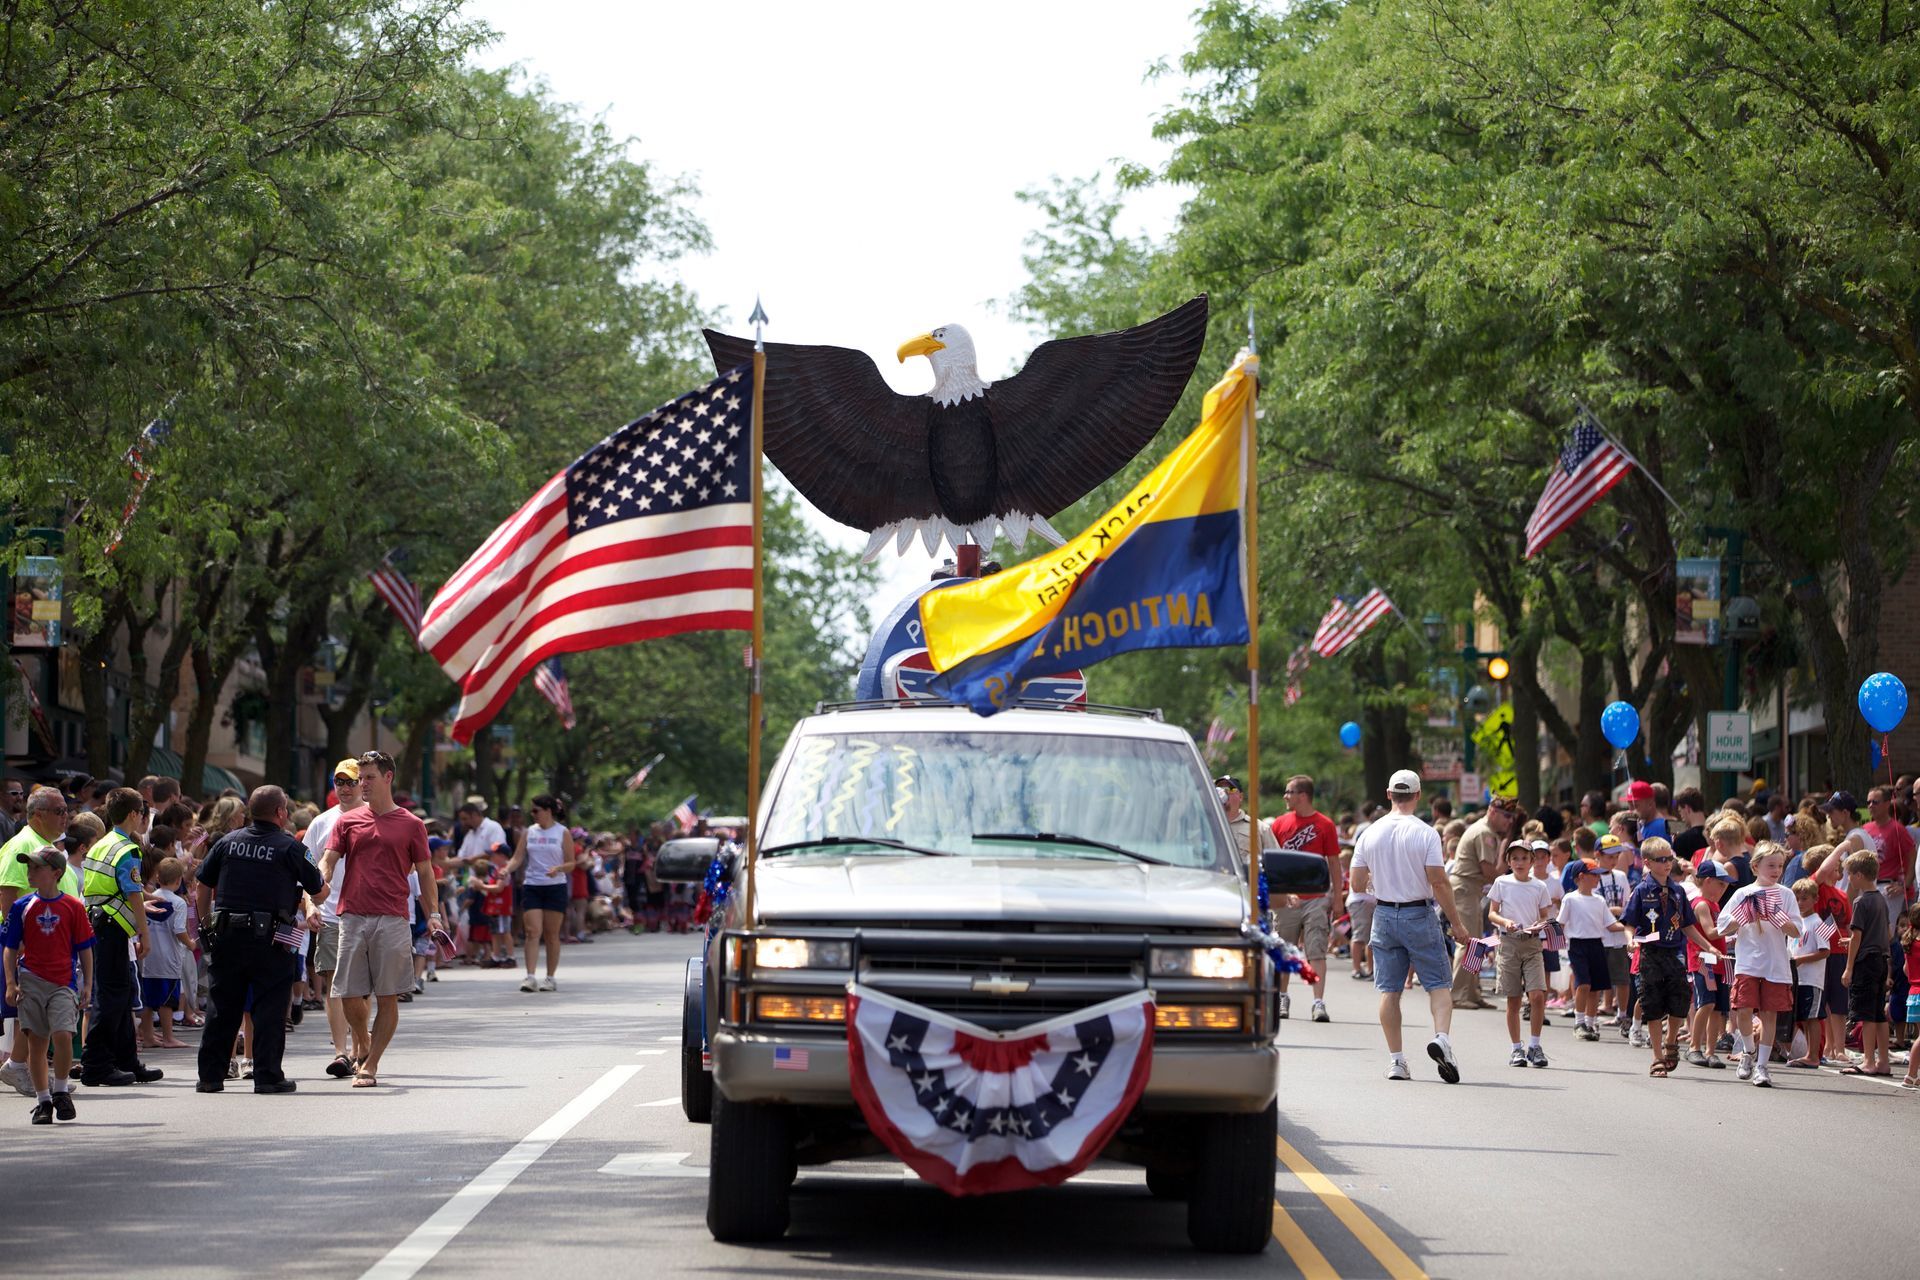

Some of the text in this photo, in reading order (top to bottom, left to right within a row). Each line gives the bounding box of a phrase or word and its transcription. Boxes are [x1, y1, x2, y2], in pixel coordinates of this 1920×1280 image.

[1726, 720, 1734, 731] 2
[1716, 735, 1743, 747] HOUR
[1710, 751, 1748, 763] PARKING
[228, 841, 275, 861] POLICE
